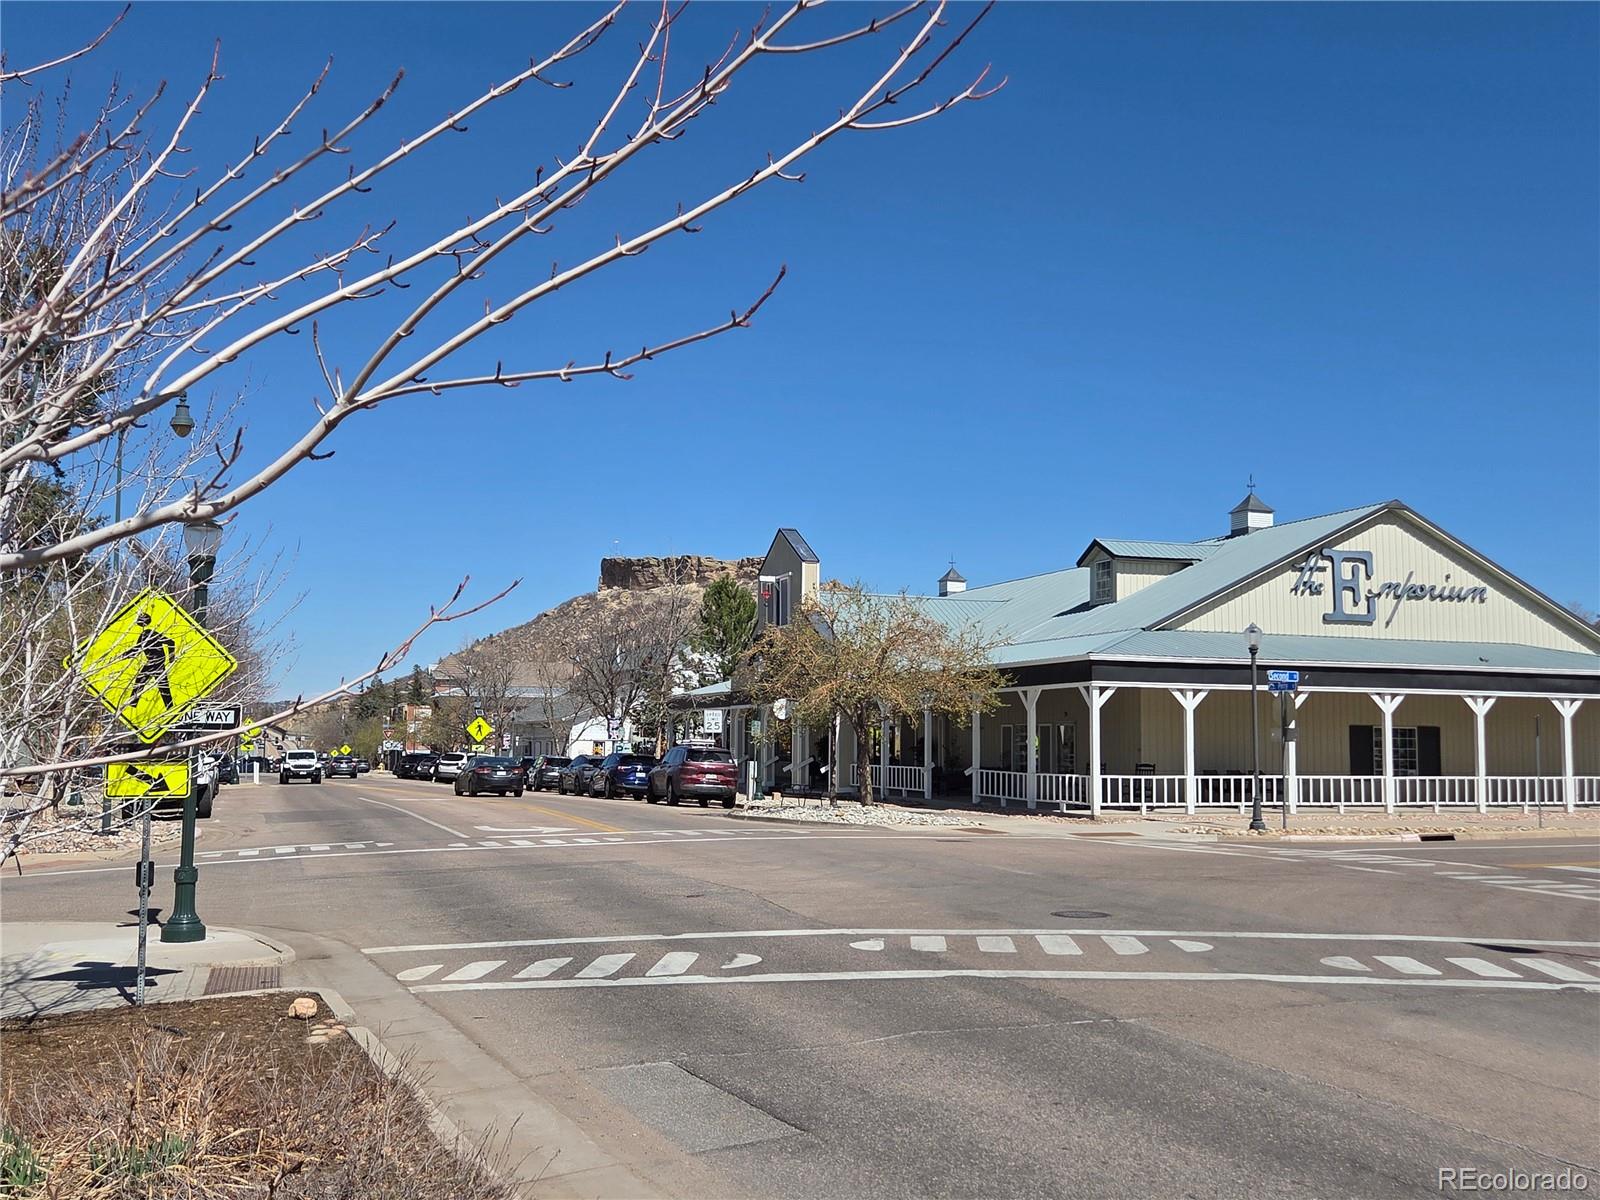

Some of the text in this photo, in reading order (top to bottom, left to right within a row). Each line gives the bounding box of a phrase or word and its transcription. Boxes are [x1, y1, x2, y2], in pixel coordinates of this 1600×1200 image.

[1322, 548, 1488, 628] Emporium
[179, 711, 231, 722] NE WAY
[706, 722, 720, 730] 25
